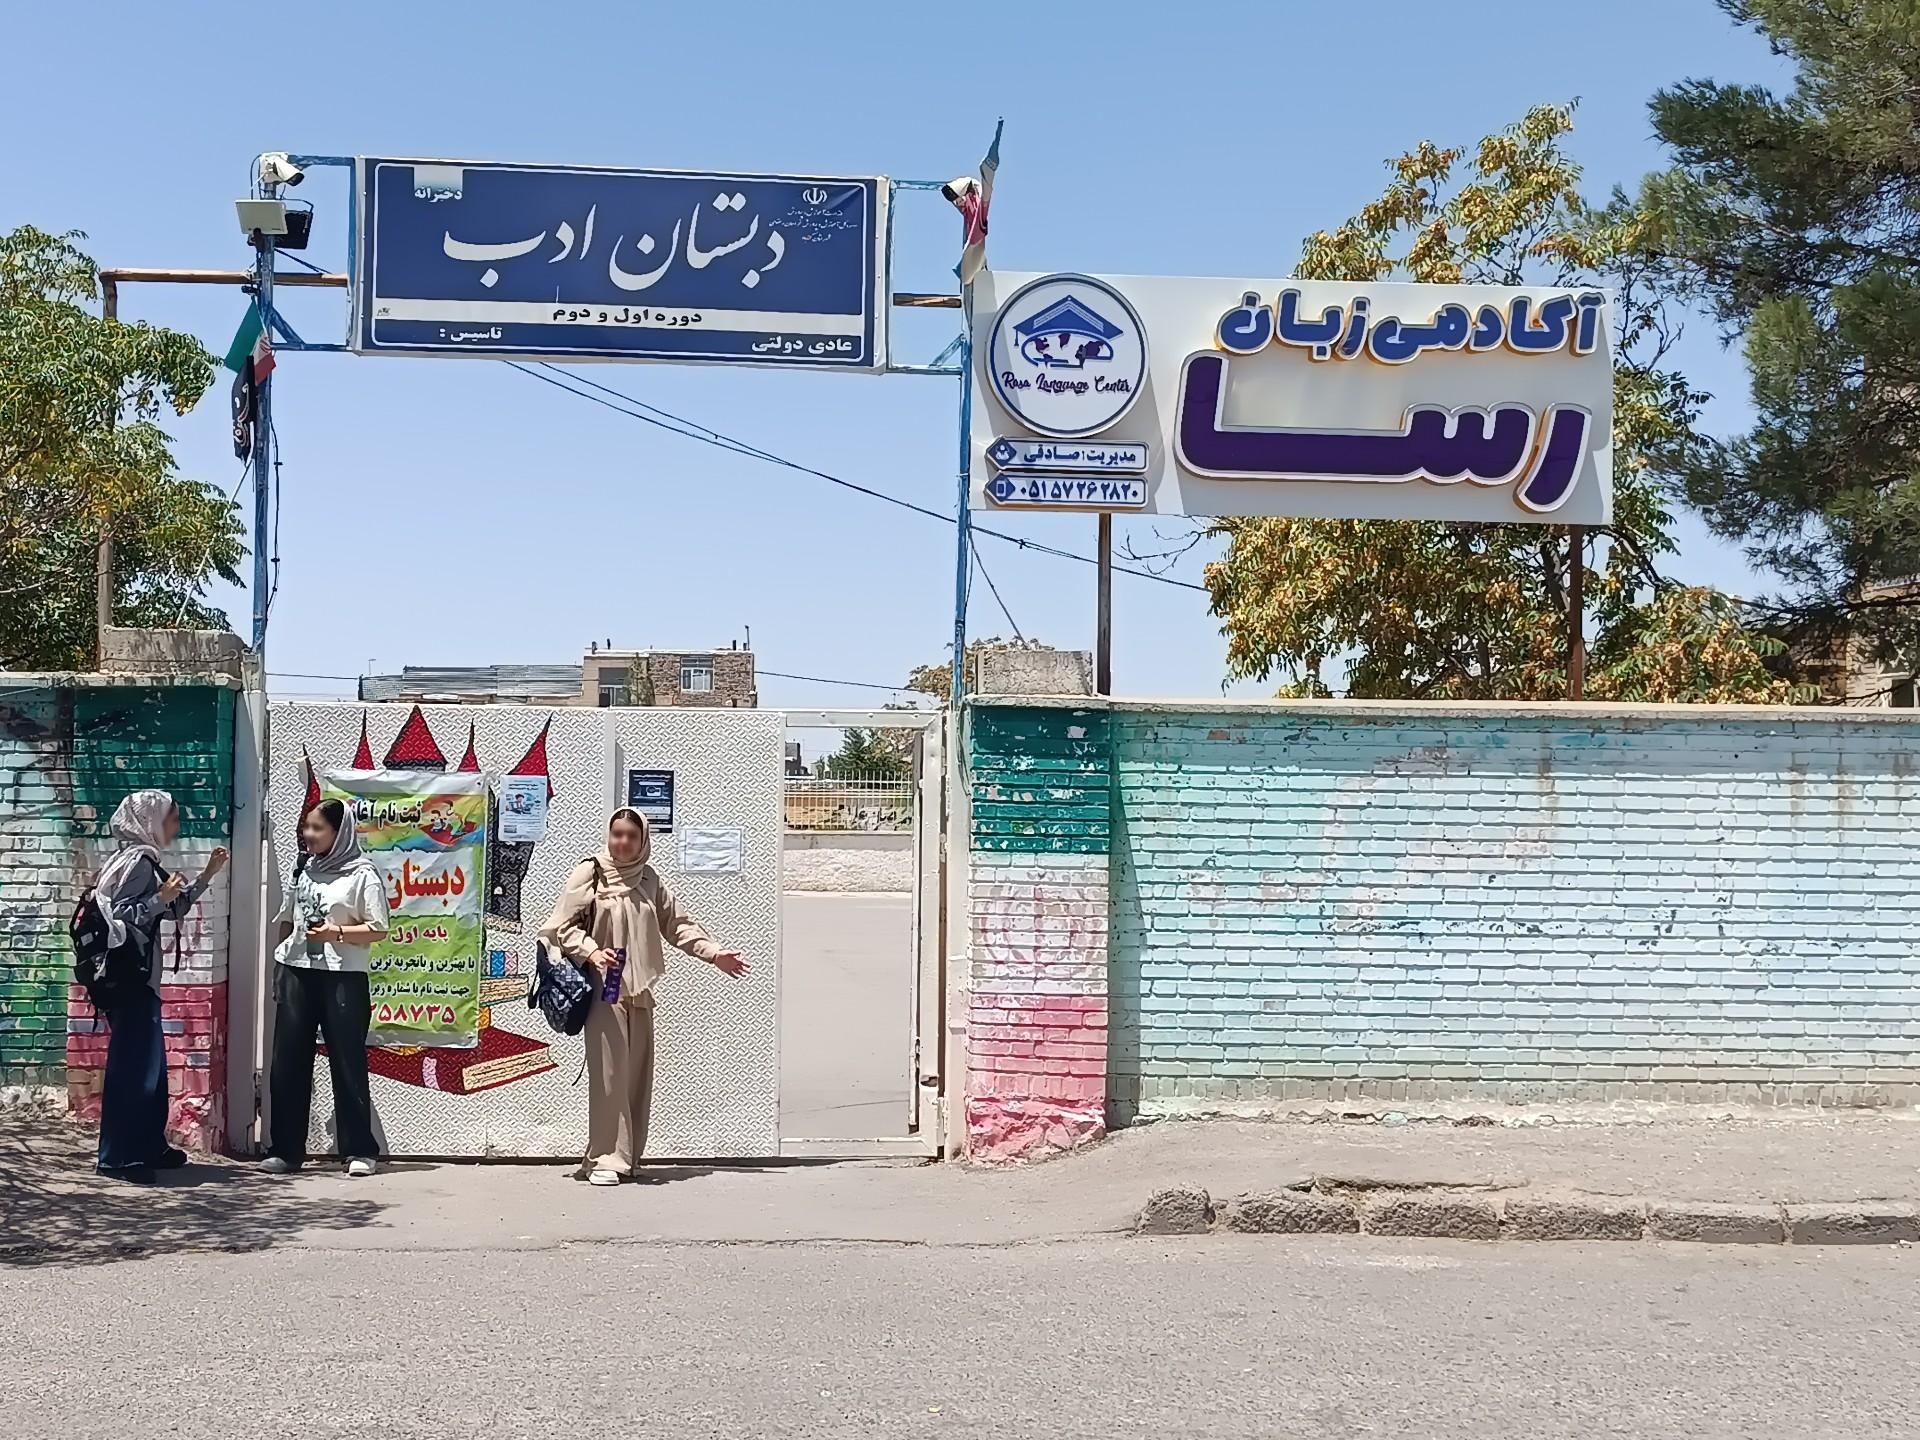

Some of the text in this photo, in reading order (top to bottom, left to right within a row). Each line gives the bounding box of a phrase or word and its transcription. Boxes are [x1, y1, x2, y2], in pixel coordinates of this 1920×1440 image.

[414, 186, 463, 203] دخترانه
[443, 192, 785, 291] دبستان ادب
[552, 308, 703, 326] دوره اول و دوم
[1216, 288, 1606, 364] آکادمی زبان
[751, 335, 852, 355] عادی دولتی
[1001, 371, 1132, 394] Rasa Language Center
[1173, 348, 1593, 513] رسا
[1023, 443, 1080, 462] صادقی
[379, 801, 396, 829] نام
[399, 800, 422, 829] ثبت
[387, 857, 465, 910] دبستان
[391, 925, 448, 944] پایه اول
